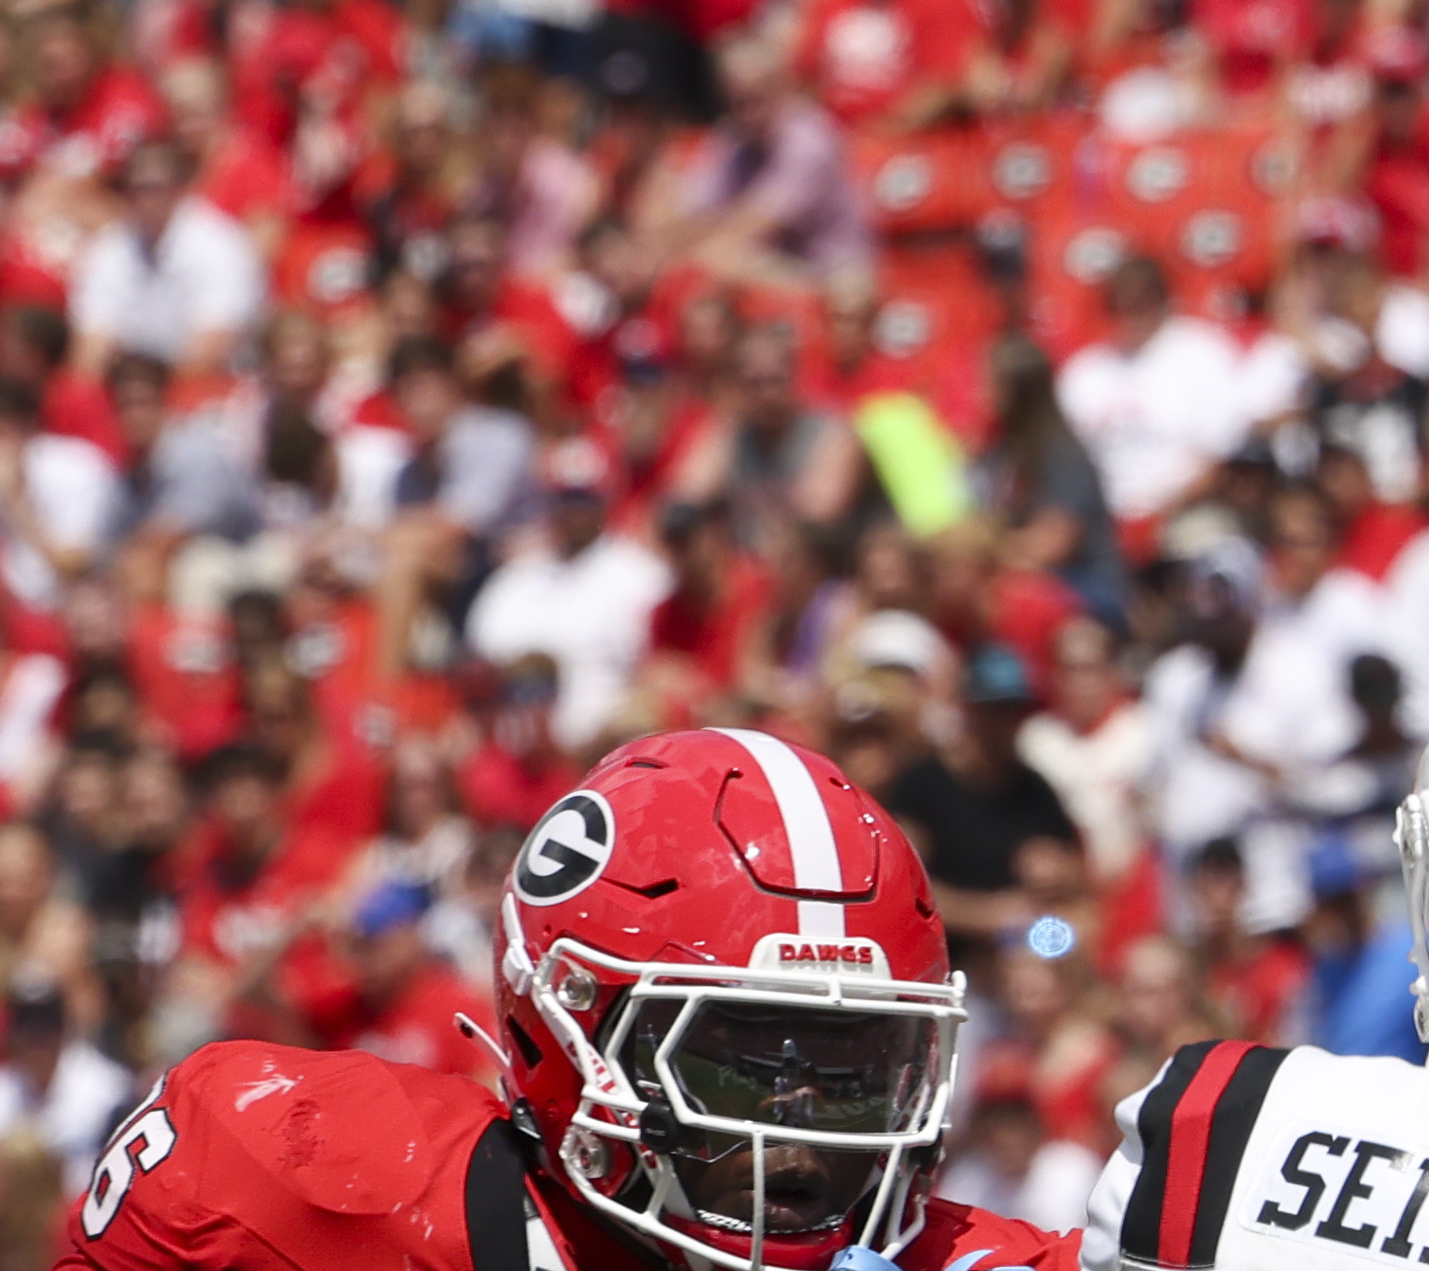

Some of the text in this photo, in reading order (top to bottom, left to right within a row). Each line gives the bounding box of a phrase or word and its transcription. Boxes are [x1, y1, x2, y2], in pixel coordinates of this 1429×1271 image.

[514, 781, 616, 907] G
[778, 943, 874, 964] DAWGS
[81, 1073, 178, 1241] 6
